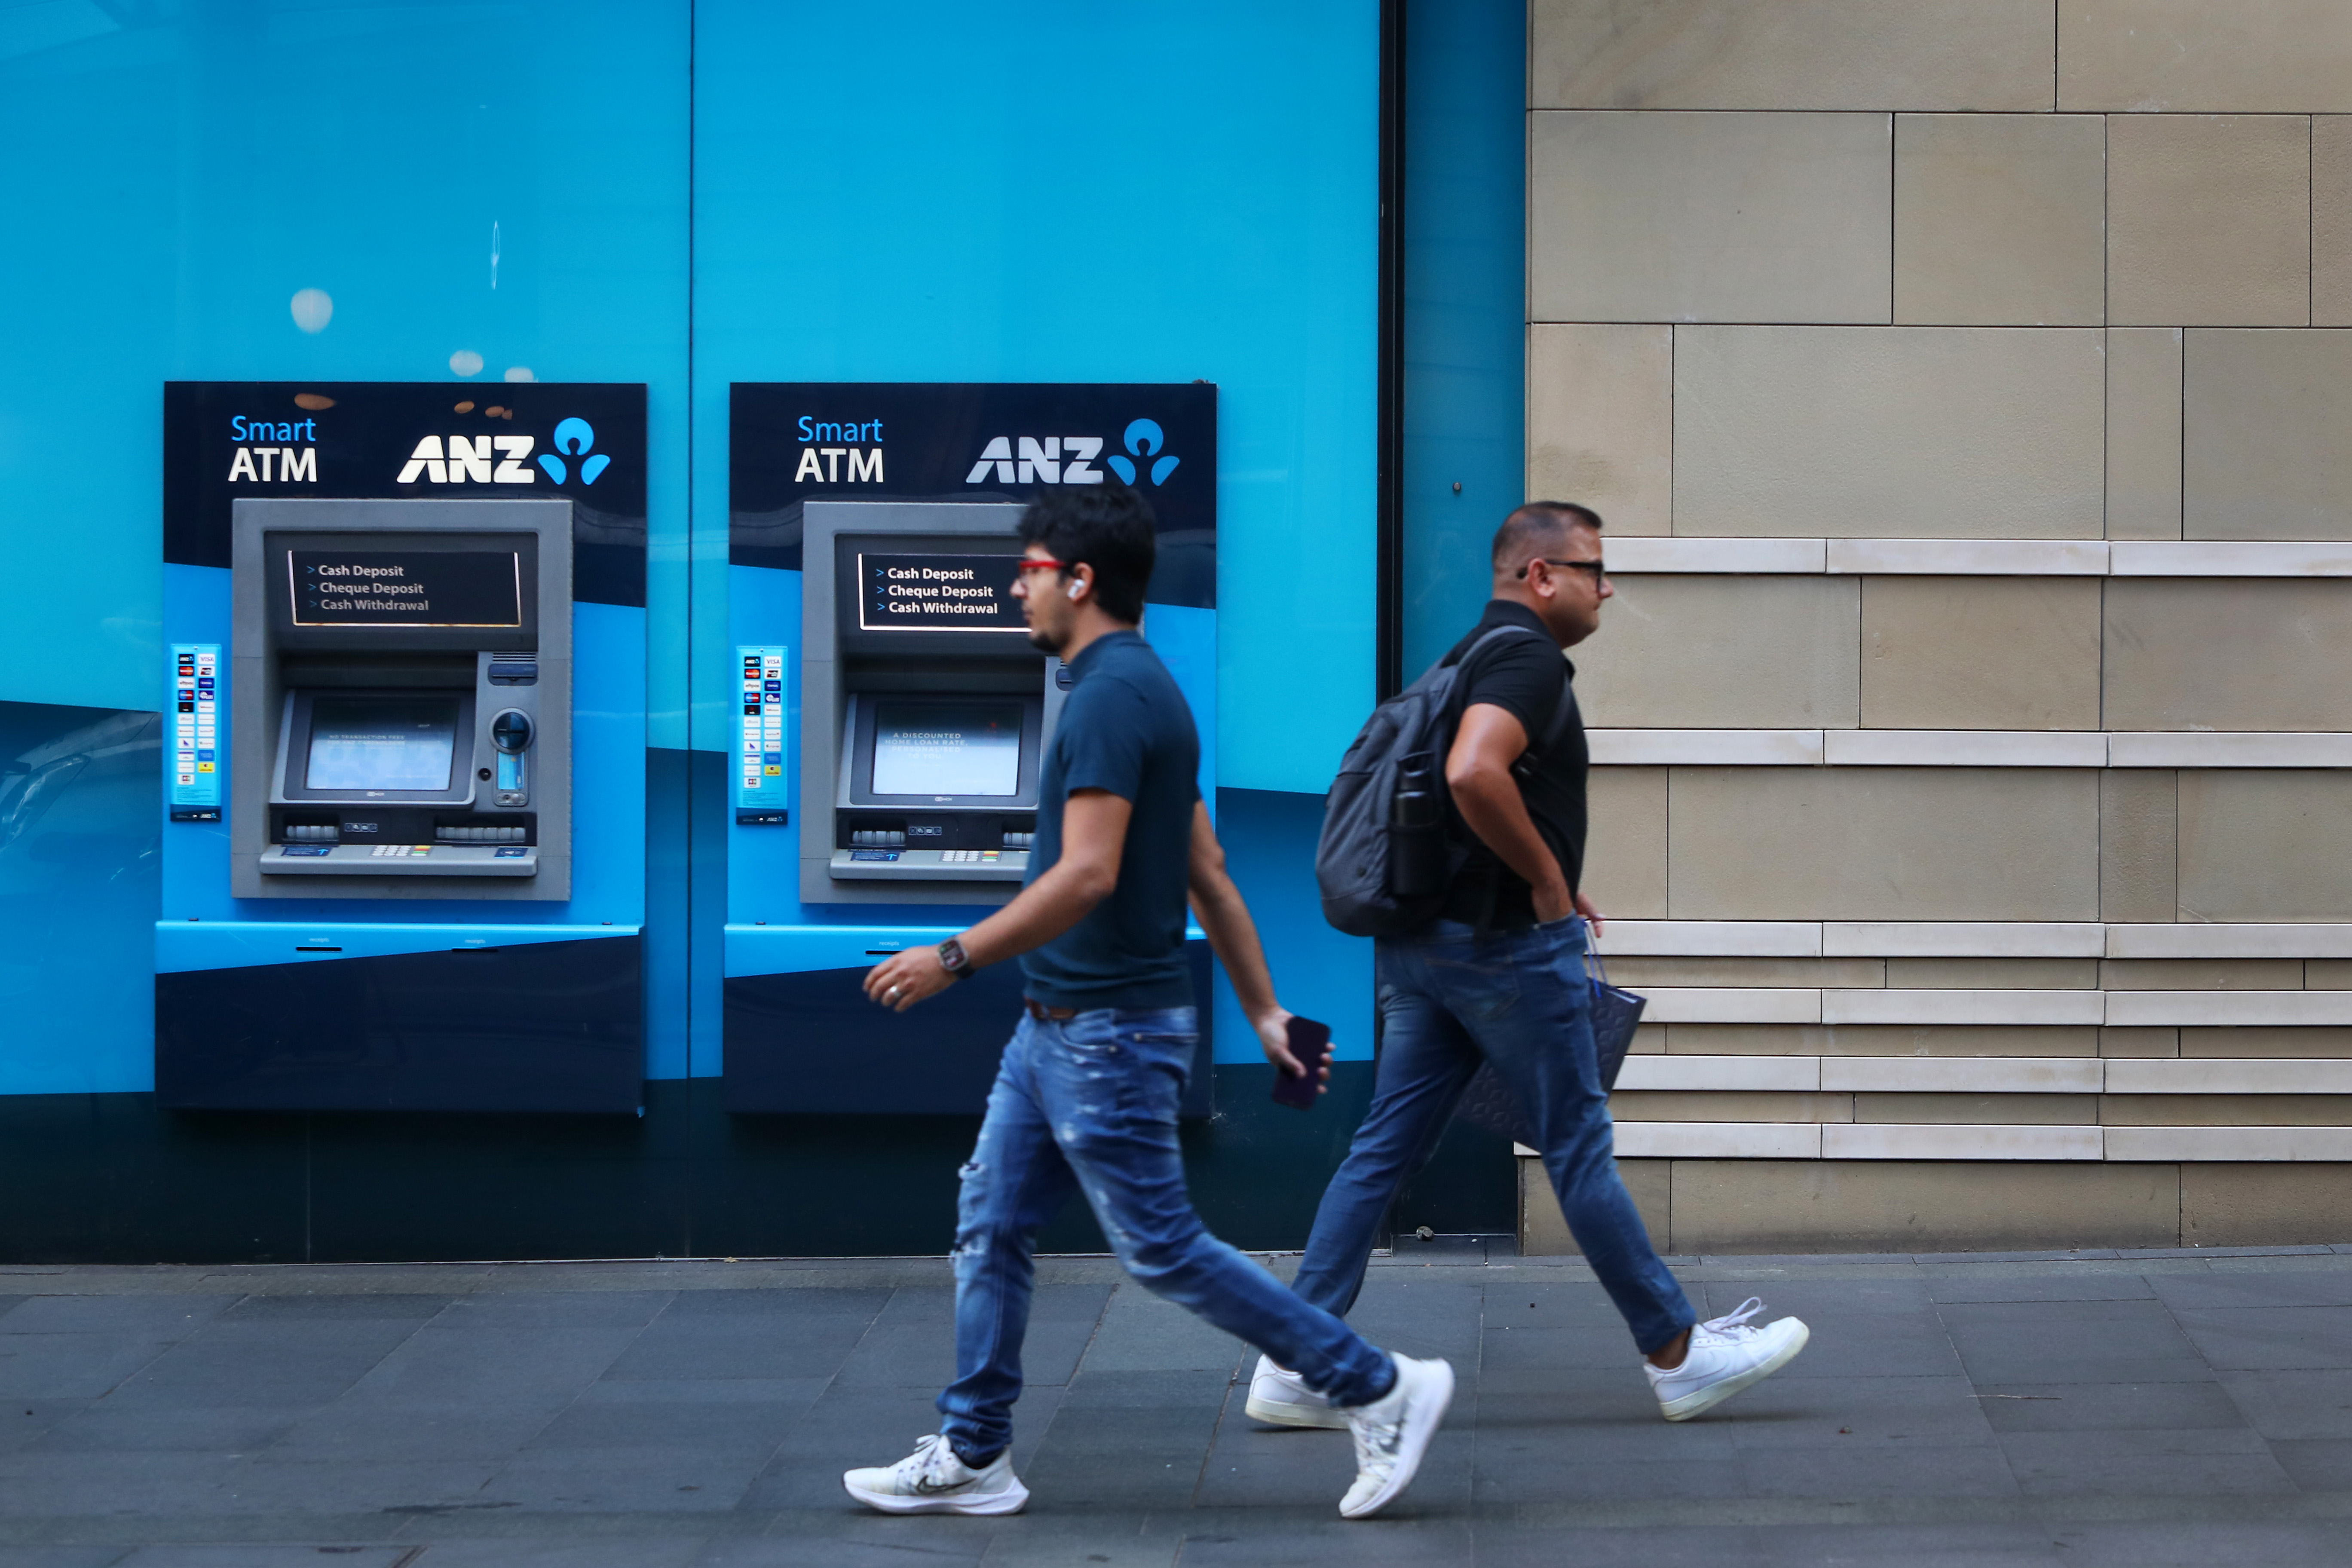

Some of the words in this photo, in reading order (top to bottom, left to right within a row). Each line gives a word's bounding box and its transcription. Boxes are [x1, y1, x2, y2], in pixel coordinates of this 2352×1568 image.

[231, 415, 316, 442] Smart
[797, 416, 883, 442] Smart
[228, 447, 317, 482] ATM
[396, 435, 535, 484] ANZ
[795, 448, 884, 483] ATM
[966, 436, 1104, 484] ANZ
[318, 565, 350, 576] Cash
[352, 565, 404, 579] Deposit
[888, 567, 919, 579] Cash
[922, 568, 974, 582] Deposit
[319, 582, 370, 596] Cheque
[372, 583, 424, 596] Deposit
[888, 585, 939, 599] Cheque
[942, 585, 994, 599] Deposit
[321, 599, 352, 610] Cash
[354, 600, 429, 611] Withdrawal
[888, 602, 920, 613] Cash
[923, 602, 998, 614] Withdrawal
